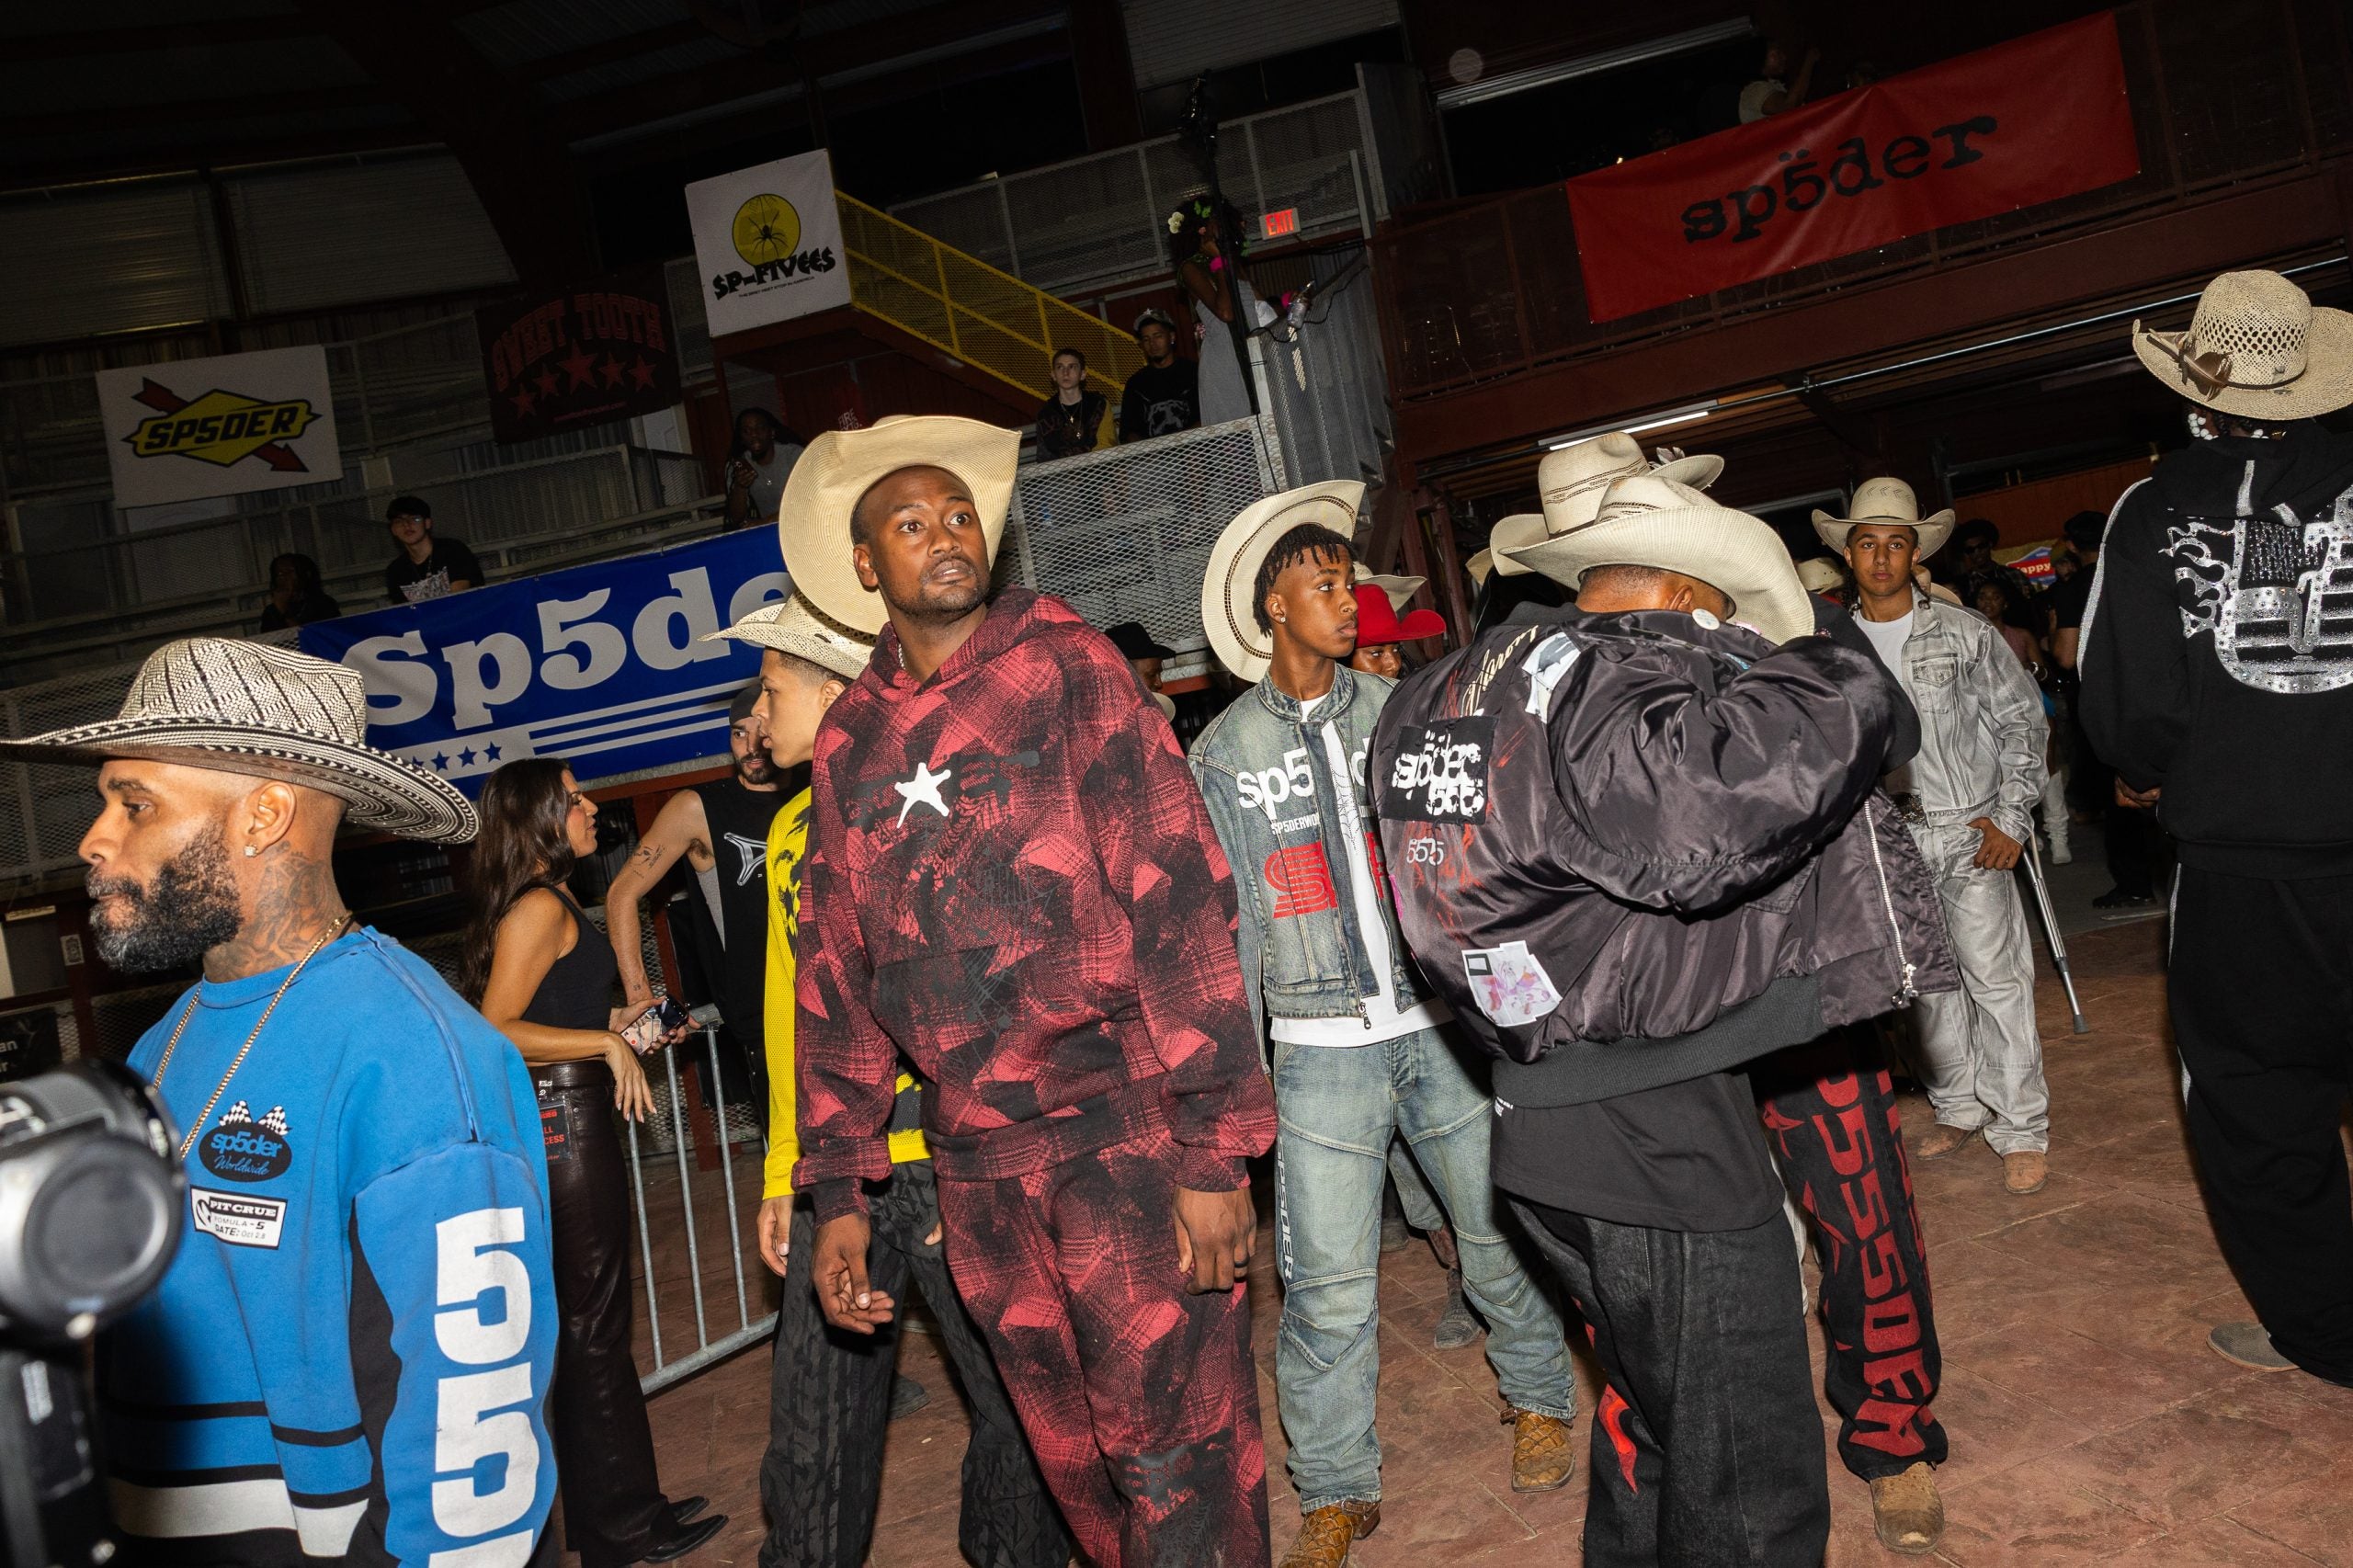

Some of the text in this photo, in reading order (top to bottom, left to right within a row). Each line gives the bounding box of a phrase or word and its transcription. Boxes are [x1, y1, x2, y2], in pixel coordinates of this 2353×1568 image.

[1266, 208, 1294, 236] EXIT
[492, 292, 667, 393] SWEET TOOTH
[210, 1131, 283, 1158] sp5der
[544, 1133, 565, 1146] CESS
[213, 1154, 271, 1176] Worldwide
[210, 1200, 278, 1218] PIT CRUE
